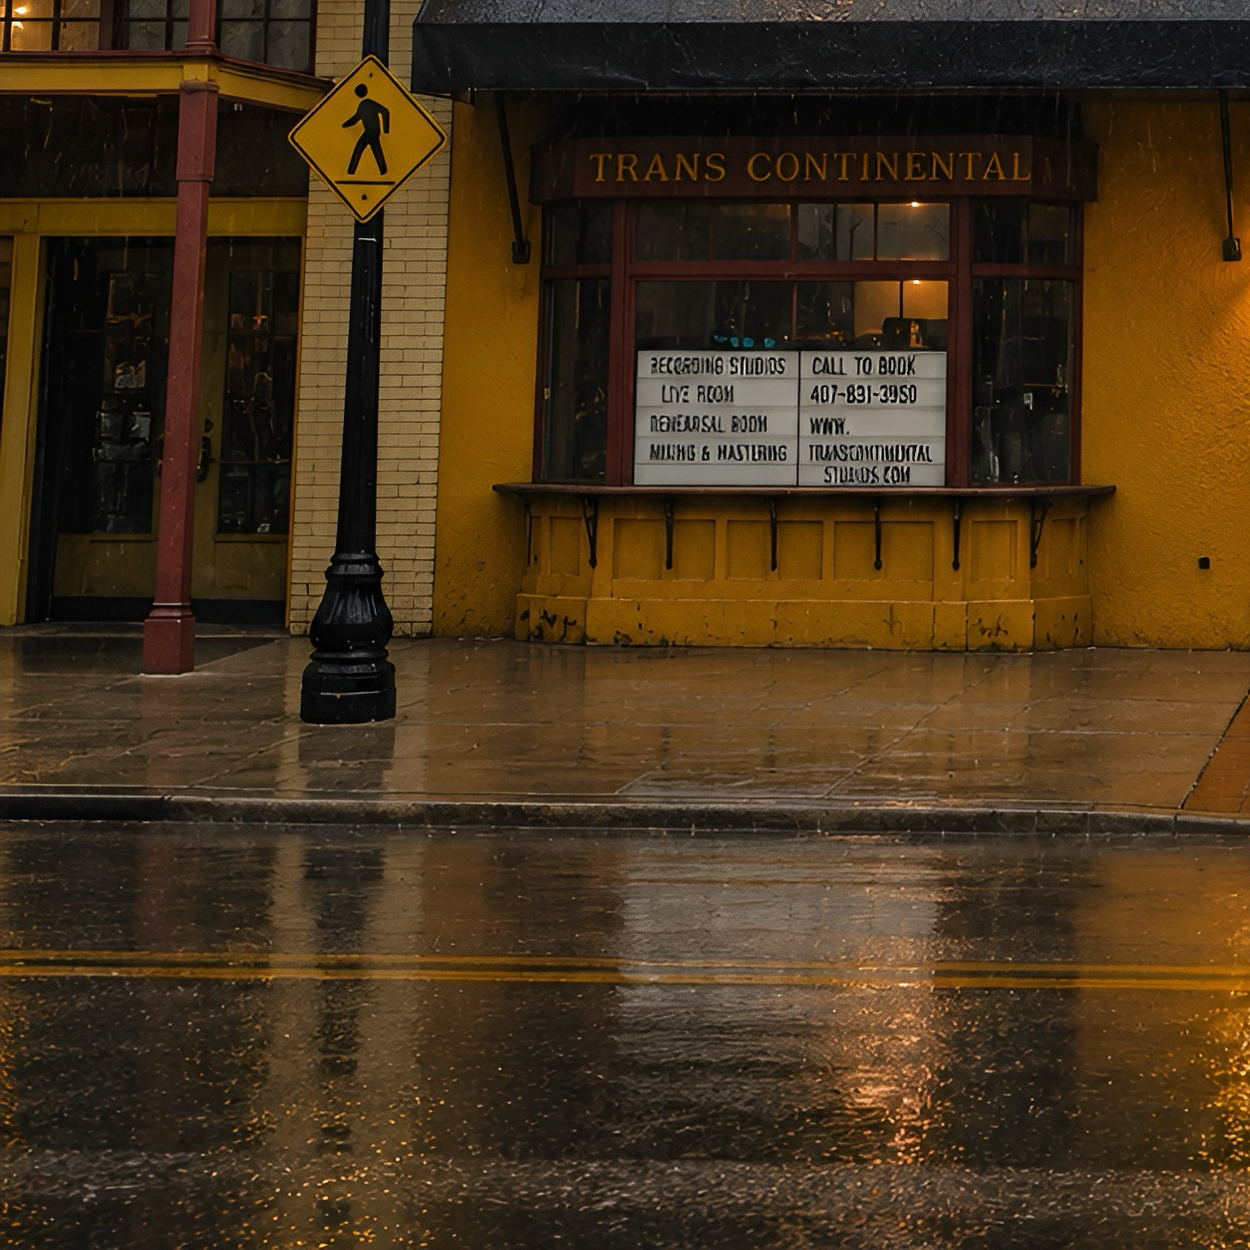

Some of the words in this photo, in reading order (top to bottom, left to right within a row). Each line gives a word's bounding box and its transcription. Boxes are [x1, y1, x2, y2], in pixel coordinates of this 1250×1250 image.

[589, 152, 727, 182] TRANS
[746, 151, 1031, 182] CONTINENTAL
[812, 356, 847, 375] CALL
[854, 356, 872, 375] TO
[878, 355, 916, 375] BOOK
